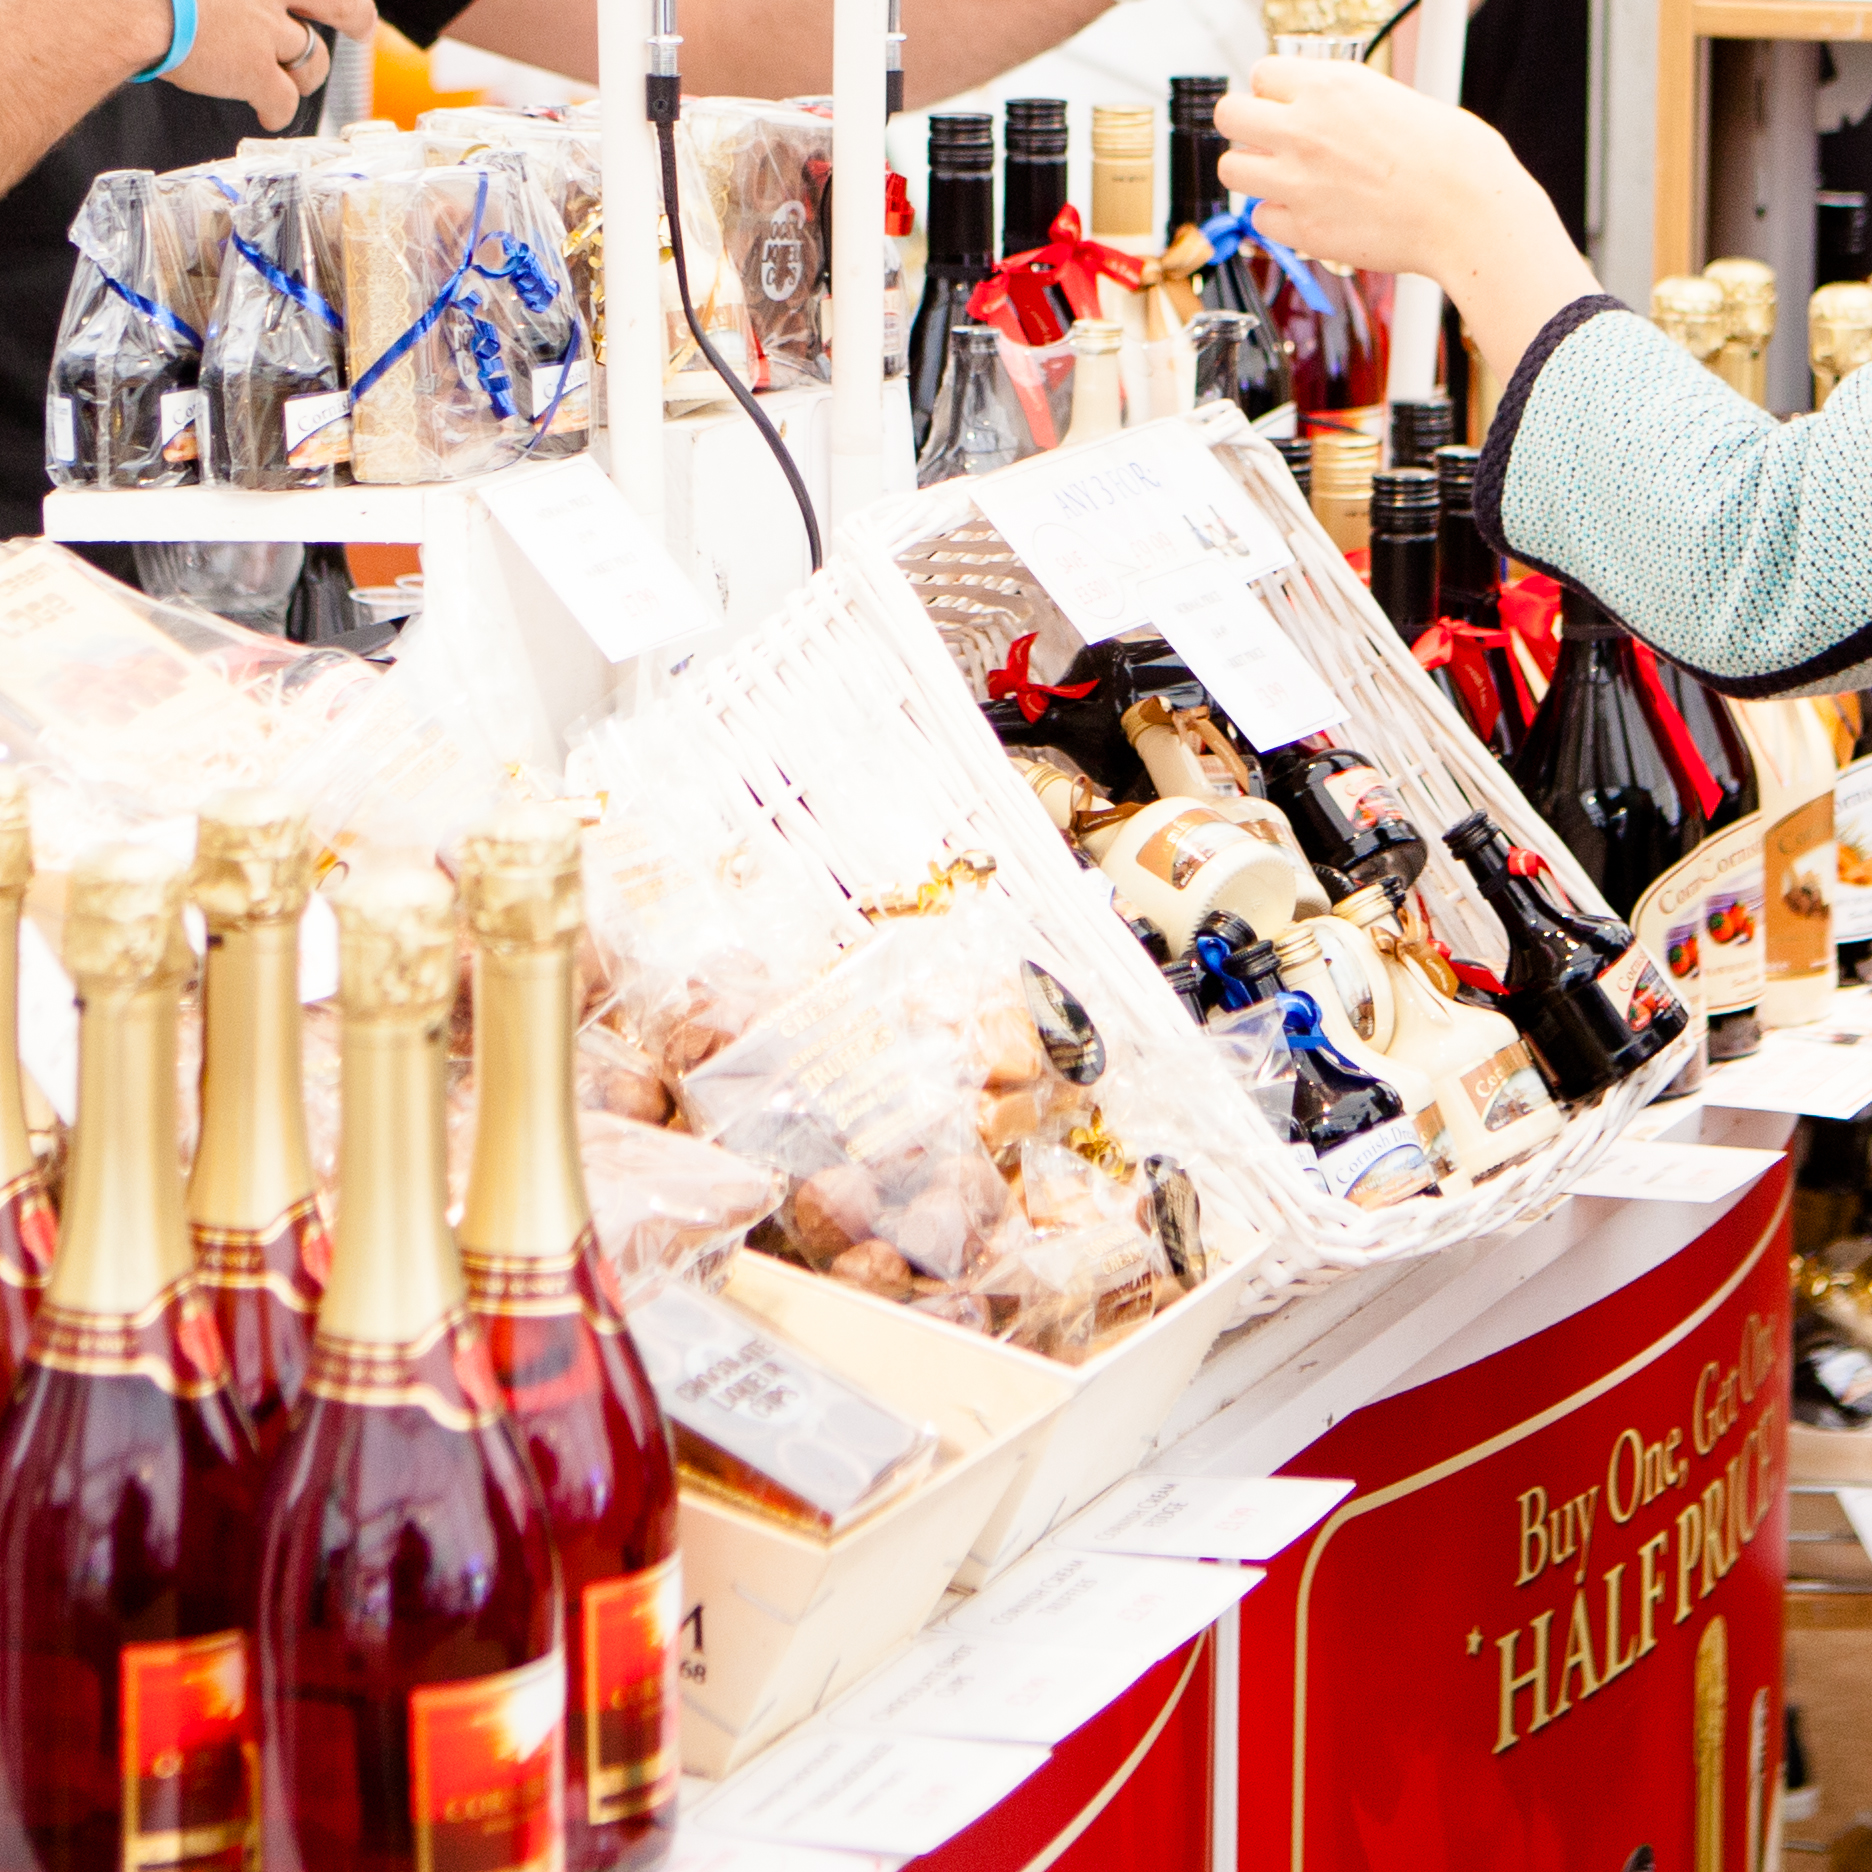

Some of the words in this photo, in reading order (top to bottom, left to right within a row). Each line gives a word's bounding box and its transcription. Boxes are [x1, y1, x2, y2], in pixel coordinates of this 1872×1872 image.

[1052, 480, 1100, 519] ANY
[1090, 476, 1115, 506] 3
[1105, 462, 1162, 500] FOR:
[1055, 550, 1088, 575] SAVE
[1130, 531, 1179, 570] £9.99
[780, 981, 855, 1039] CREAM
[1336, 1130, 1390, 1185] Cornish
[1514, 1485, 1602, 1589] Buy
[1606, 1427, 1691, 1526] One,
[1691, 1360, 1741, 1458] Get
[1094, 1509, 1151, 1542] CORNISH
[1136, 1483, 1181, 1511] CREAM
[1142, 1501, 1190, 1529] FUDGE
[990, 1588, 1052, 1626] CORNISH
[1039, 1559, 1088, 1590] CREAM
[1035, 1578, 1098, 1616] TRUFFLES
[1491, 1529, 1670, 1755] HALF
